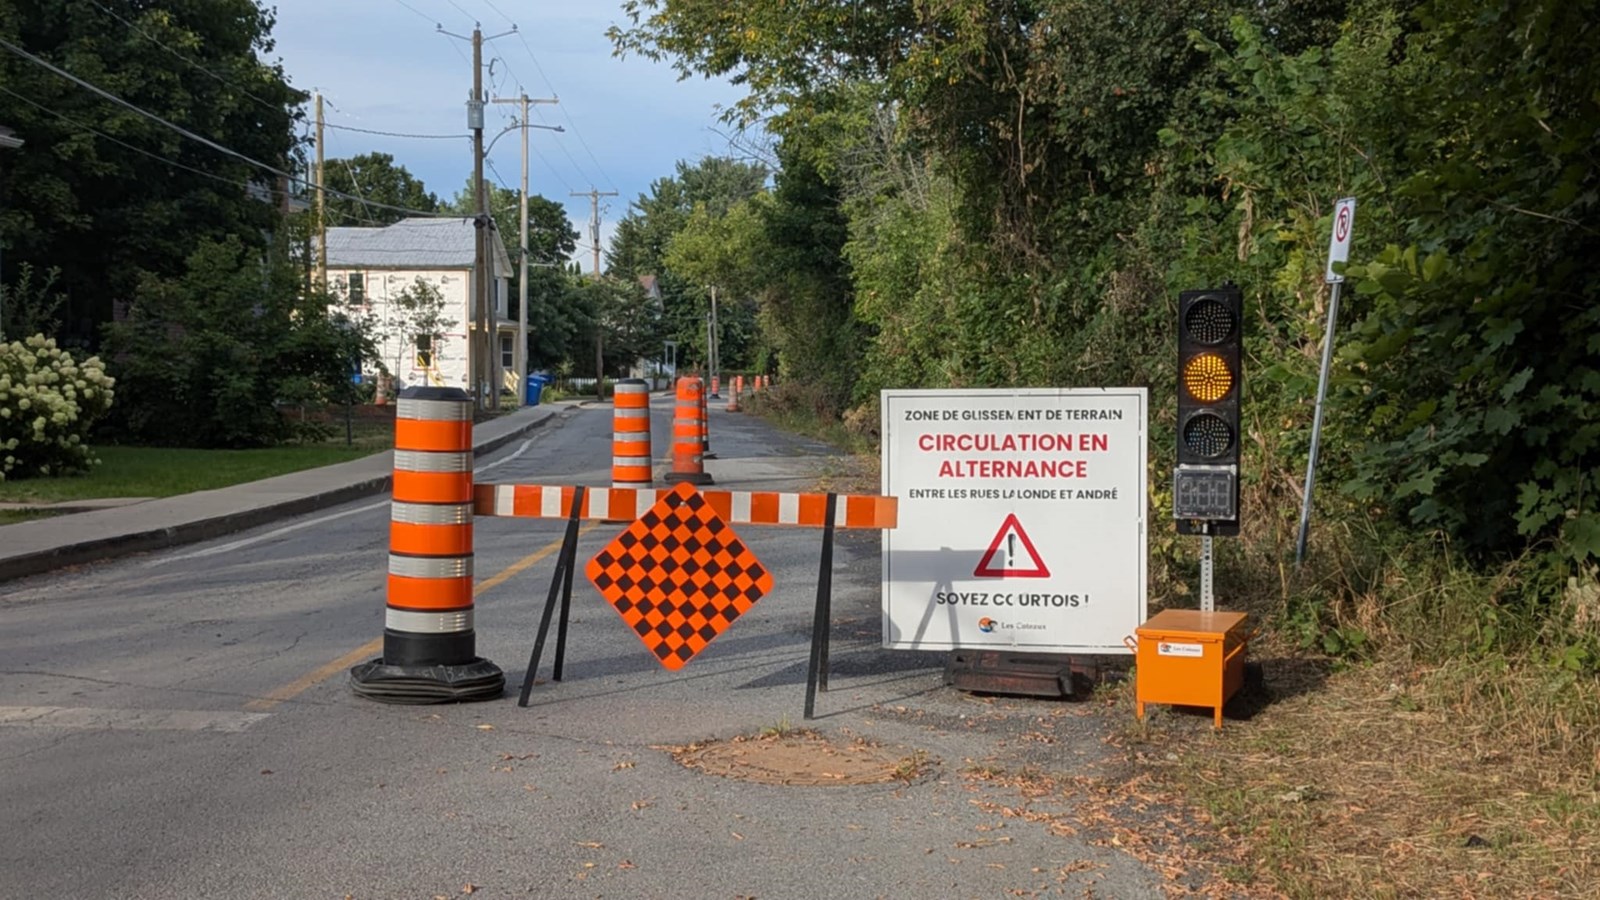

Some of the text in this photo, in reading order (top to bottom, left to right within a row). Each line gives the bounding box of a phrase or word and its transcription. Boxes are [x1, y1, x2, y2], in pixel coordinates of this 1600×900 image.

[904, 410, 940, 421] ZONE
[942, 410, 959, 421] DE
[1045, 409, 1062, 420] DE
[1065, 409, 1123, 420] TERRAIN
[918, 434, 1108, 451] CIRCULATION EN
[939, 460, 1088, 478] ALTERNANCE
[909, 489, 946, 499] ENTRE
[948, 489, 968, 499] LES
[970, 489, 1000, 499] RUES
[1059, 489, 1073, 499] ET
[1076, 487, 1118, 500] ANDRÉ
[936, 592, 989, 606] SOYEZ
